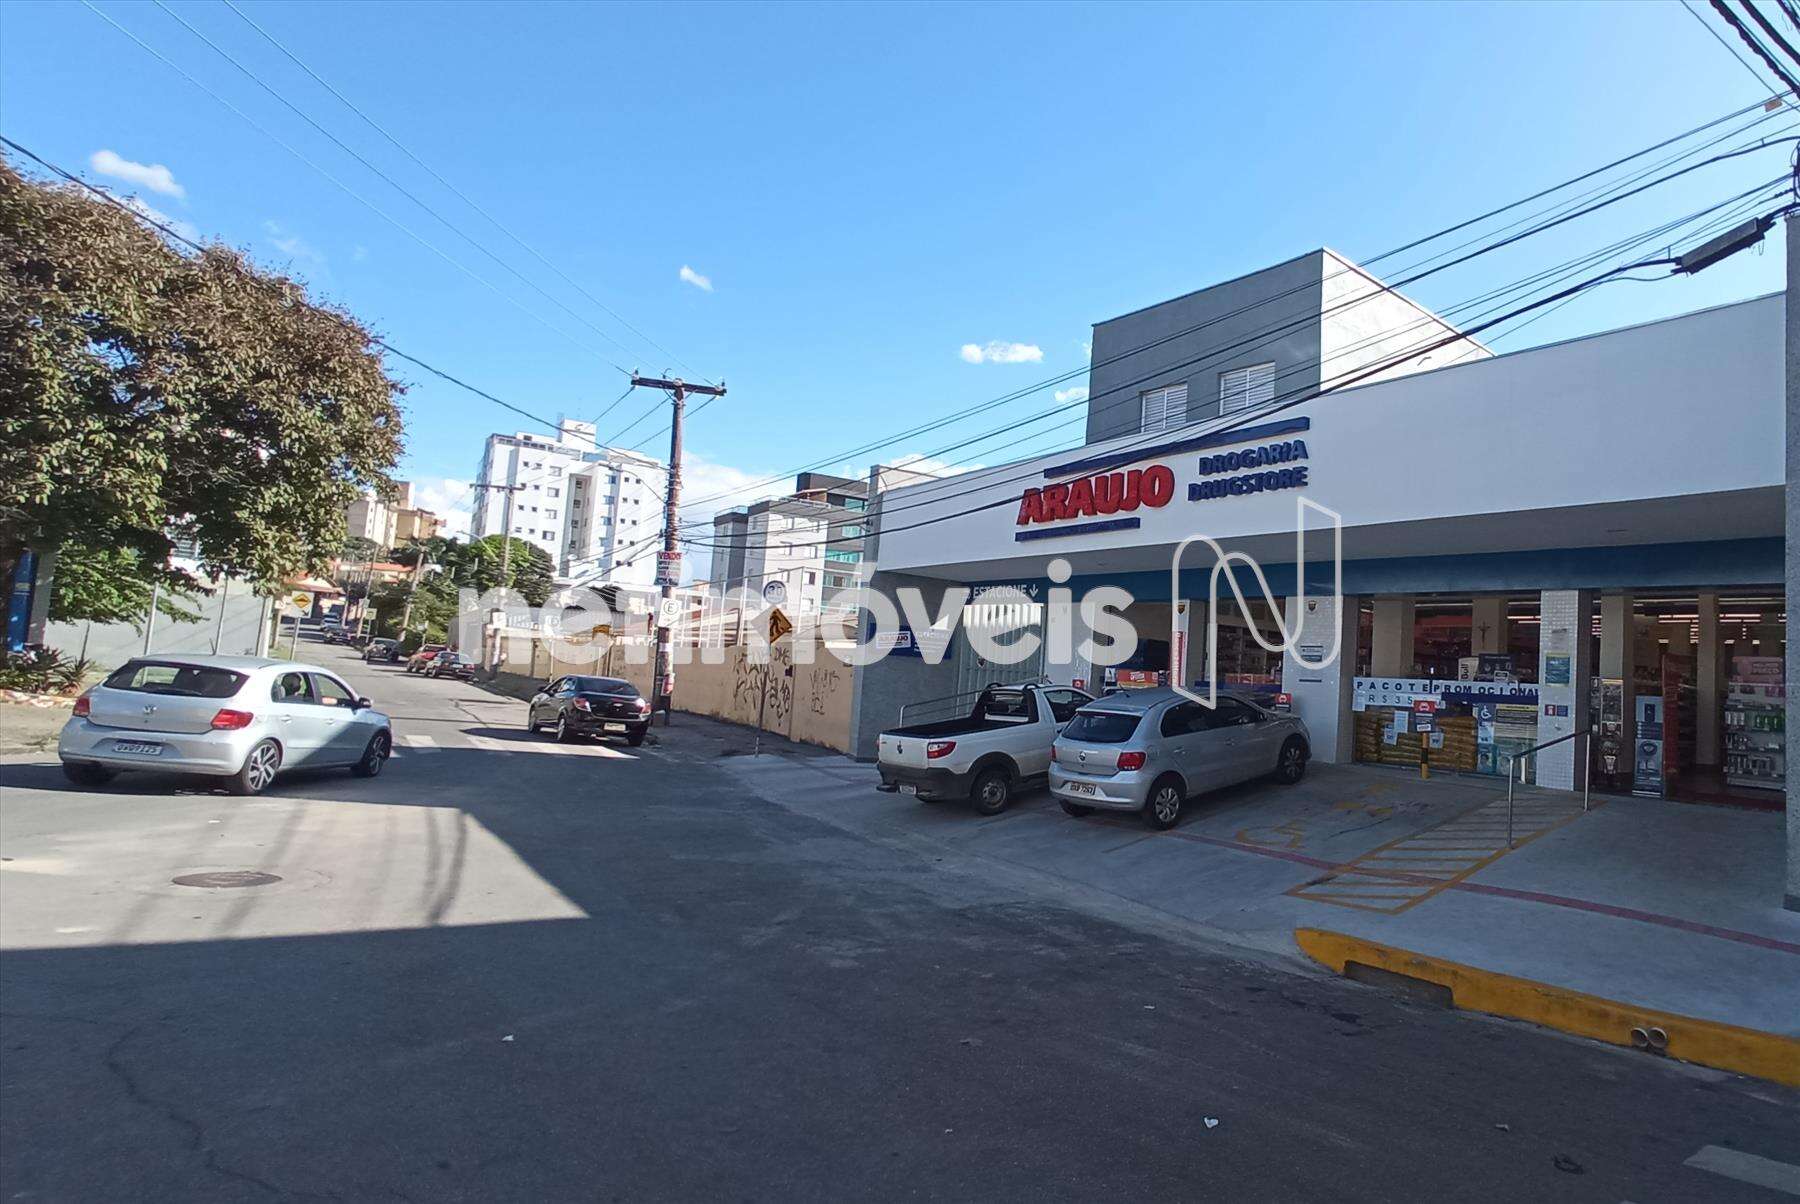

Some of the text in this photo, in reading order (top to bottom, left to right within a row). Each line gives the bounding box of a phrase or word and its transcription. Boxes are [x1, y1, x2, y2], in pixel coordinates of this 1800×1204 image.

[1199, 439, 1309, 476] DROGARIA
[1016, 464, 1175, 525] ARAUJO
[1188, 466, 1309, 502] DRUGSTORE
[1356, 681, 1429, 692] PACOTE
